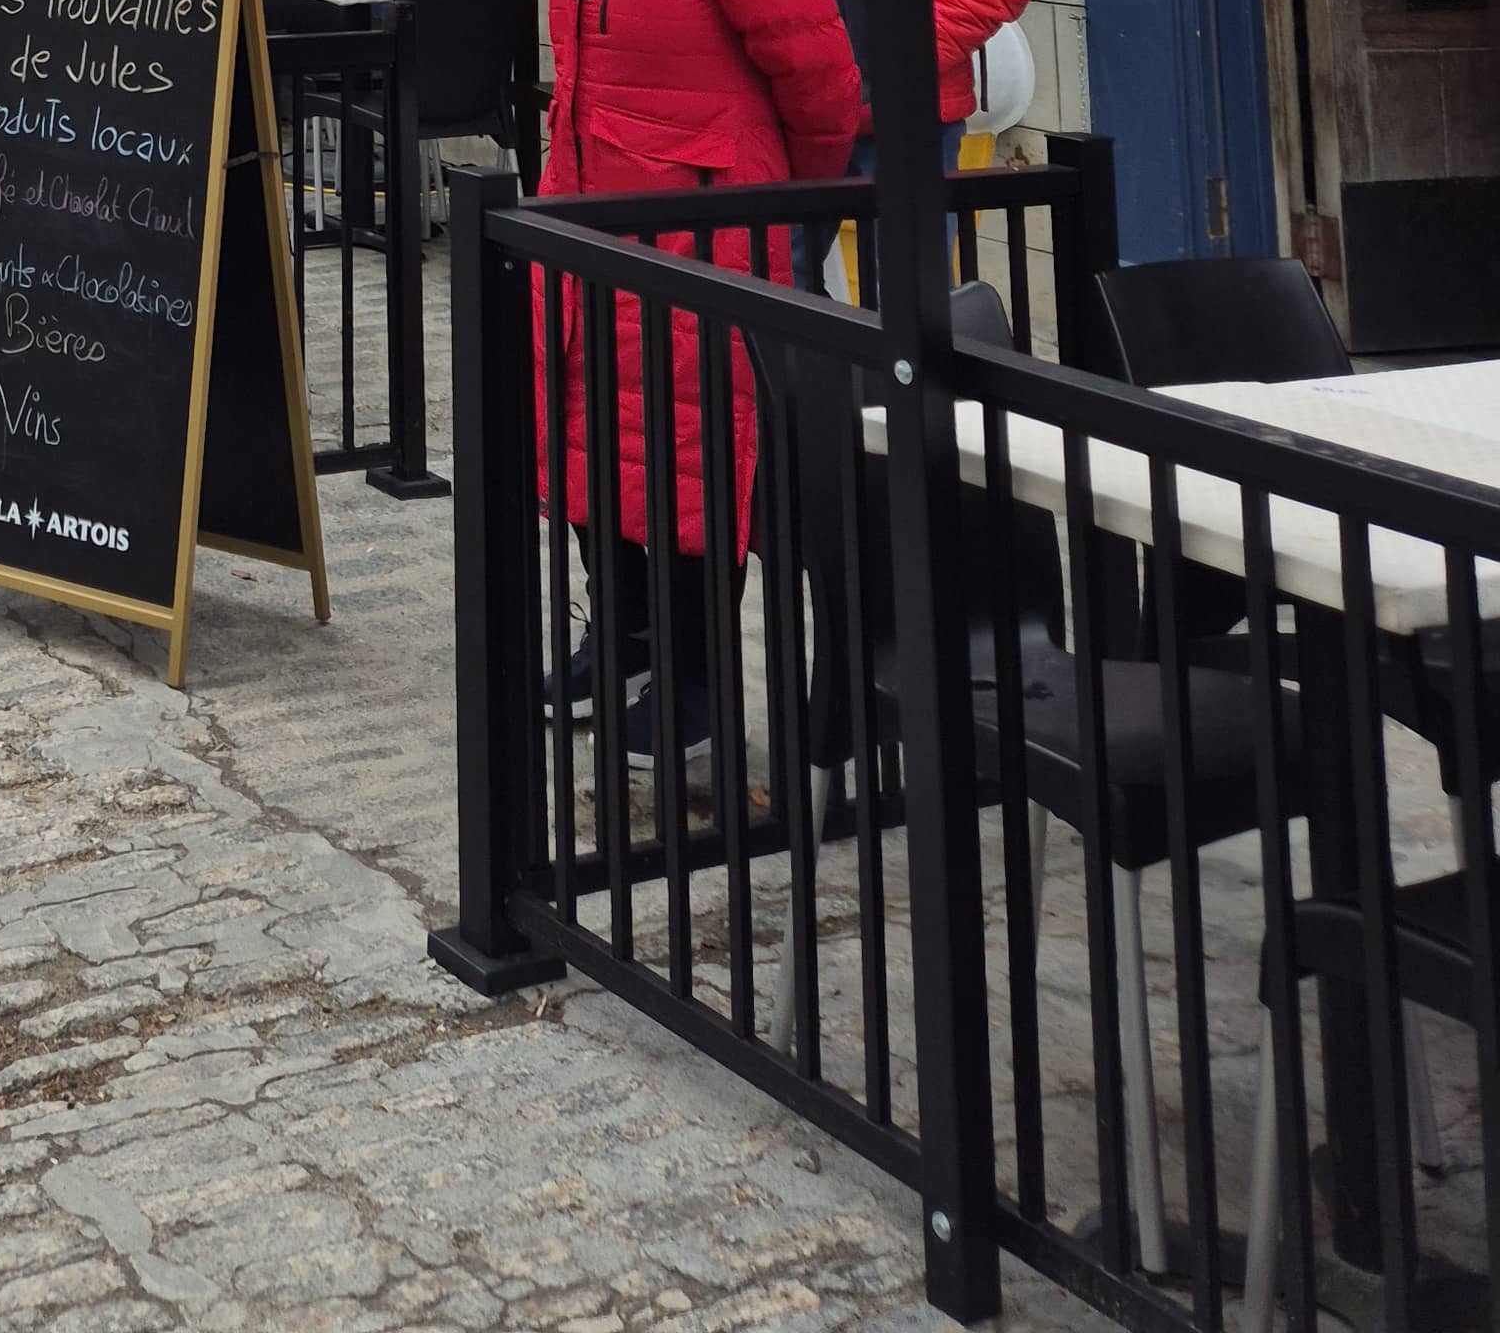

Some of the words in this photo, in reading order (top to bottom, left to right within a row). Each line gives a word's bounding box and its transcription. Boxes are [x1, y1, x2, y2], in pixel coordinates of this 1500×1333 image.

[10, 34, 52, 83] de
[65, 39, 174, 93] Jules
[23, 170, 48, 207] et
[1, 293, 106, 362] Bières
[46, 512, 130, 551] ARTOIS
